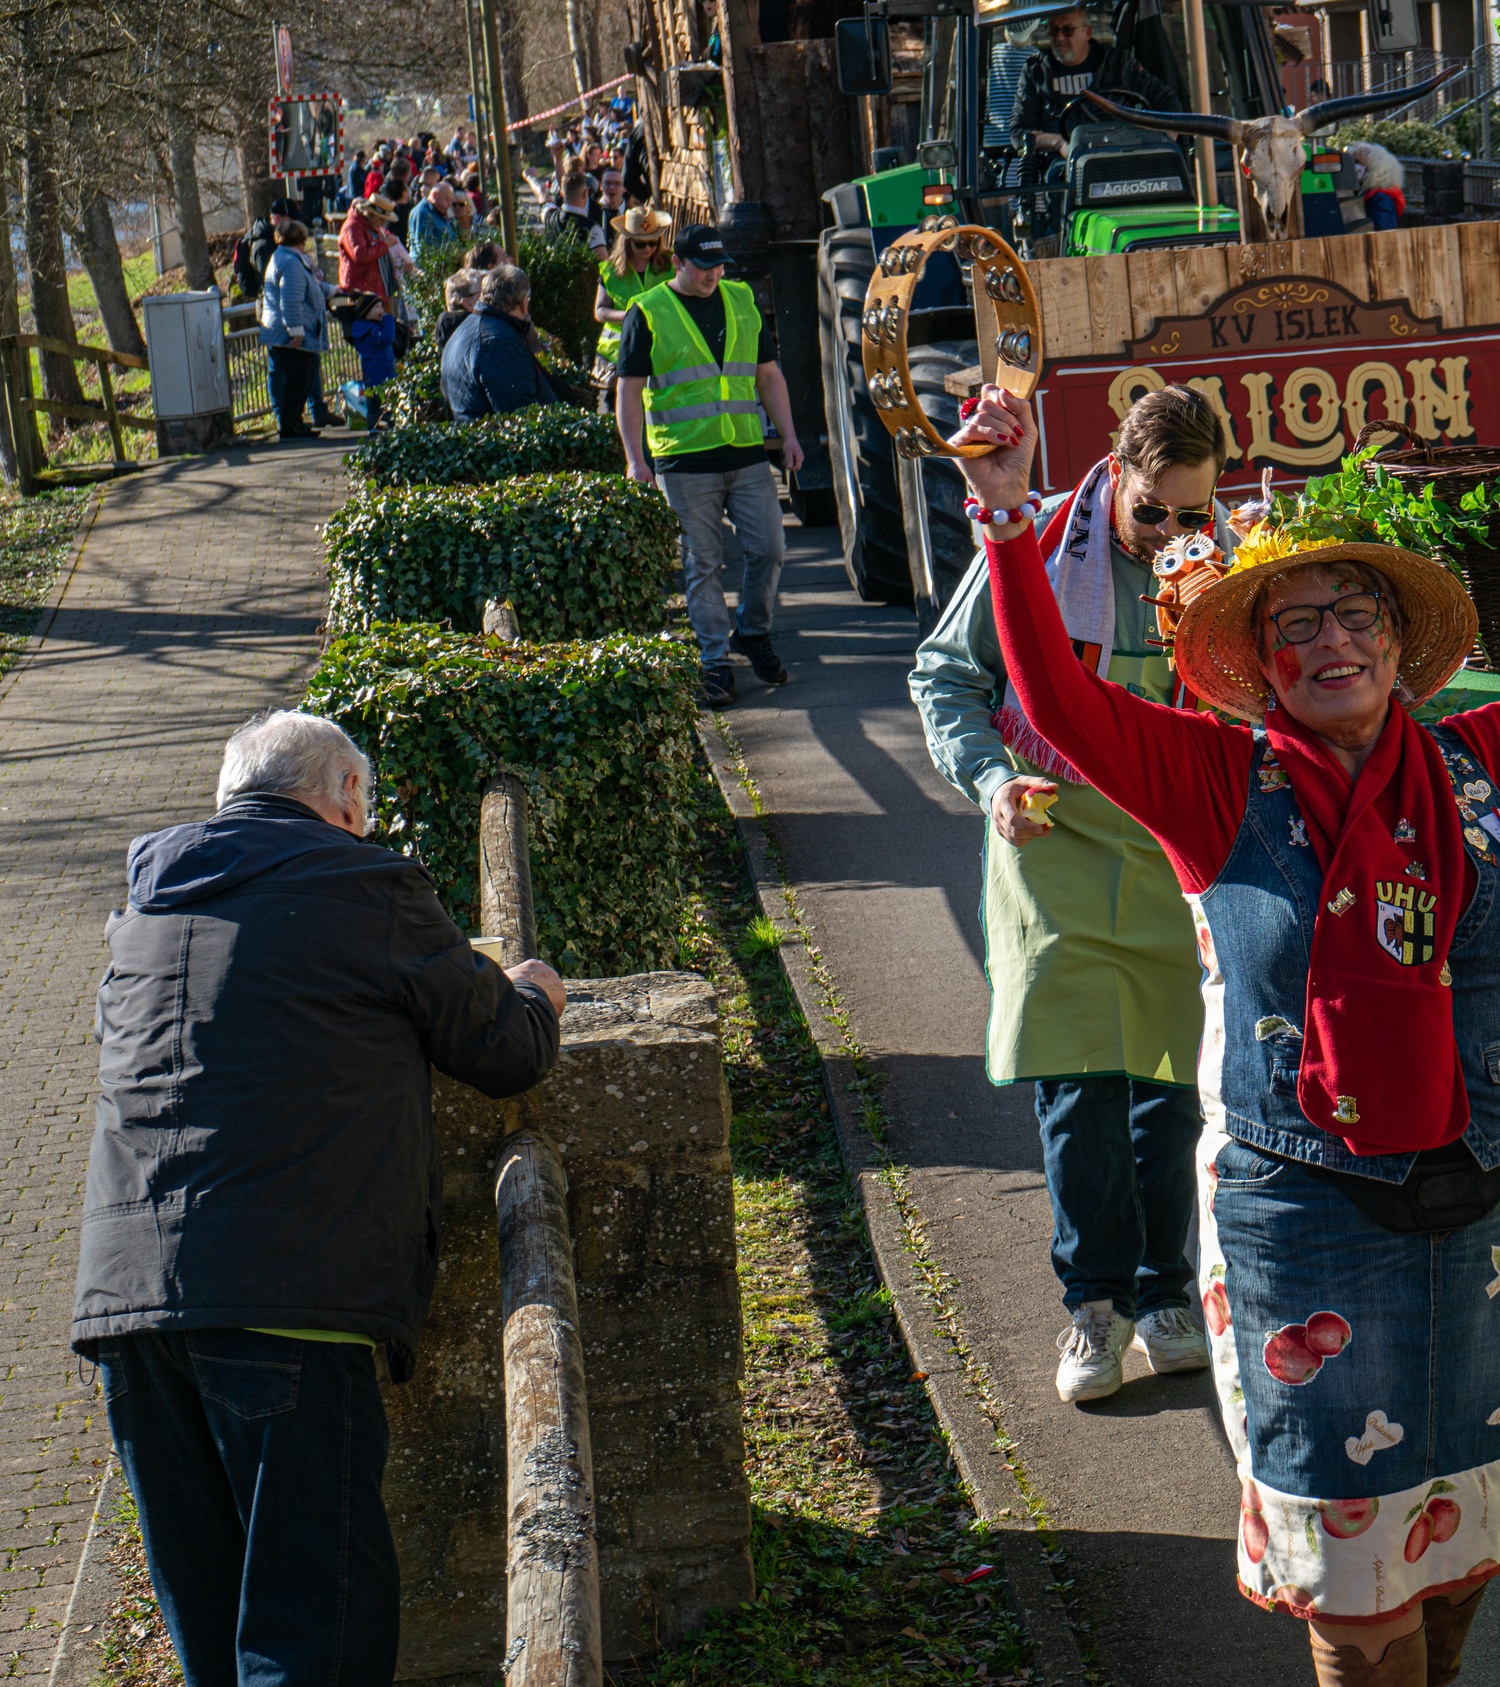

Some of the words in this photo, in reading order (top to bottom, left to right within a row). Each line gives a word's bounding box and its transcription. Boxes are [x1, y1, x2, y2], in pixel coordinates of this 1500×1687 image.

[1208, 313, 1256, 348] KV
[1275, 304, 1361, 342] ISLEK
[1375, 881, 1437, 913] UHU
